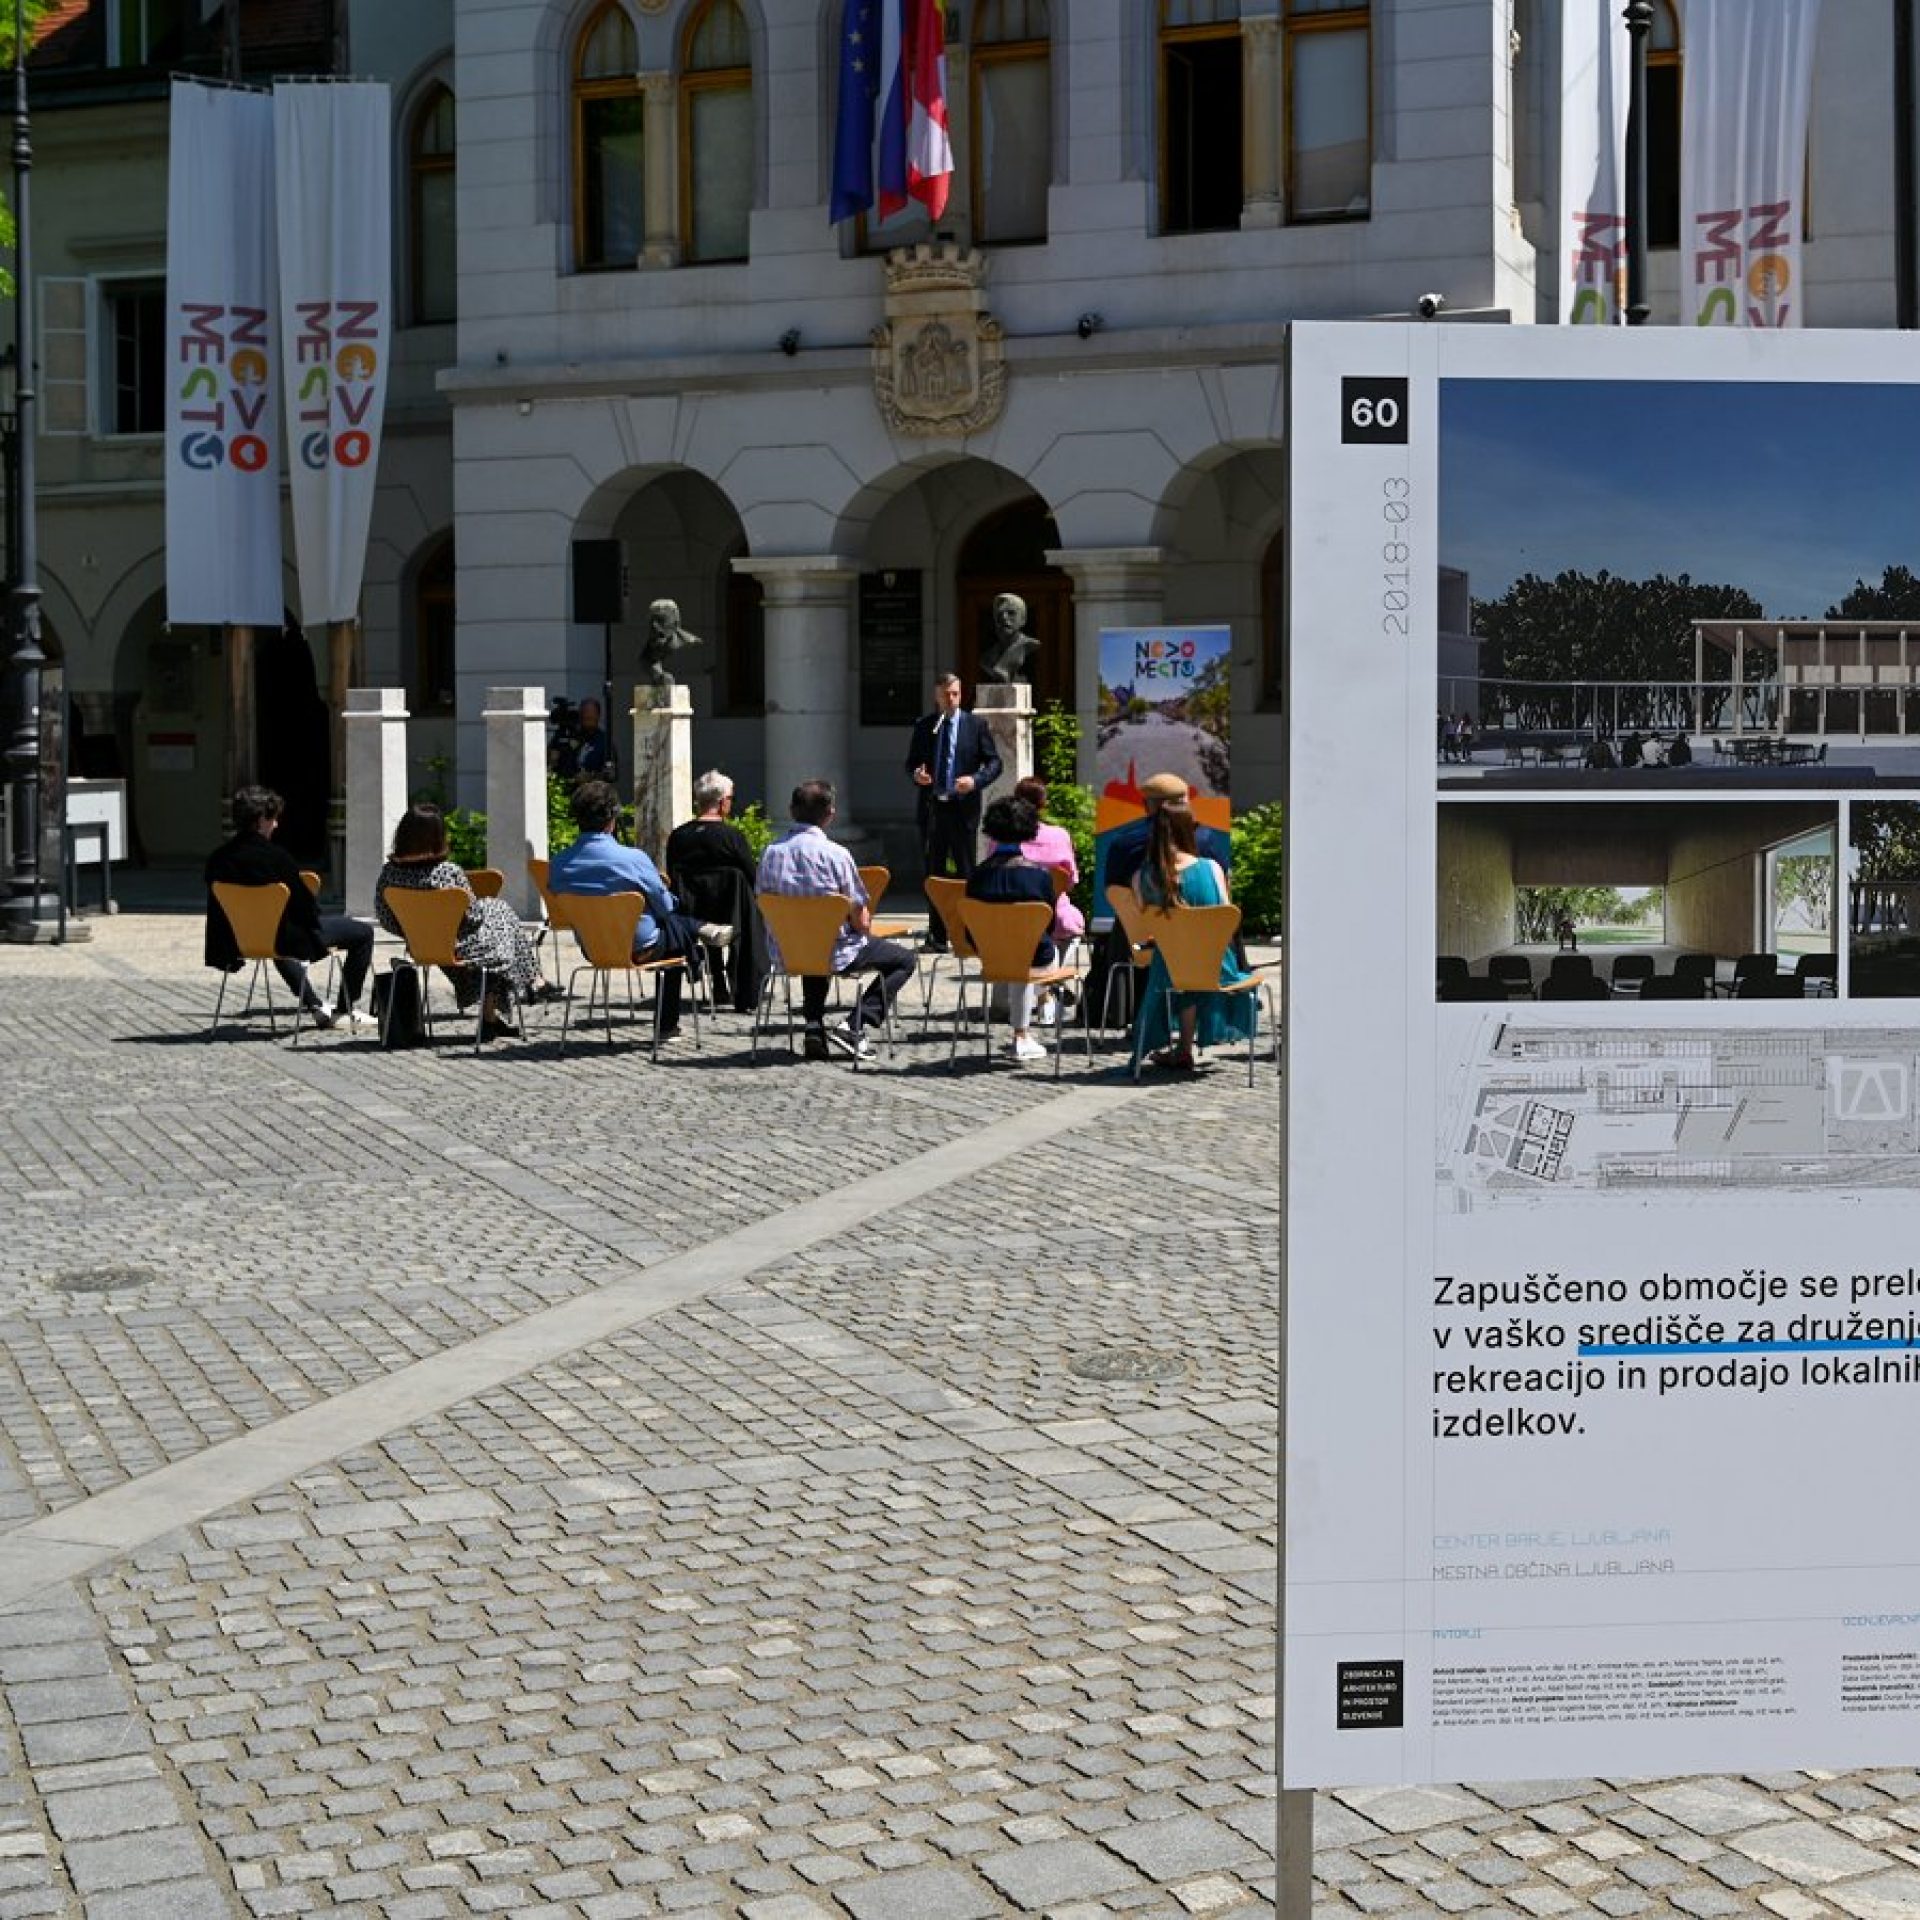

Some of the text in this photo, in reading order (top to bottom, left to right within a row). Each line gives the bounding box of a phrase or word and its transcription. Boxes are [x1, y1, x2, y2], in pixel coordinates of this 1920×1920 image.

[179, 303, 225, 470] MESTO
[229, 306, 269, 472] NOVO
[295, 302, 332, 470] MESTO
[334, 302, 379, 468] NOVO
[1351, 398, 1399, 428] 60
[1383, 477, 1410, 635] 2018-03
[1135, 640, 1195, 658] NOVO
[1135, 659, 1195, 678] MESTO
[1433, 1268, 1920, 1312] Zapuščeno območje se prel
[1433, 1310, 1920, 1349] v vaško središče za druženj
[1433, 1361, 1605, 1397] rekreacijo
[1618, 1361, 1646, 1389] in
[1659, 1356, 1789, 1396] prodajo
[1433, 1407, 1585, 1438] izdelkov.
[1433, 1534, 1499, 1549] CENTER
[1572, 1528, 1671, 1545] LJUBLJANA
[1433, 1558, 1675, 1581] MESTNA OBČINA LJUBLJANA
